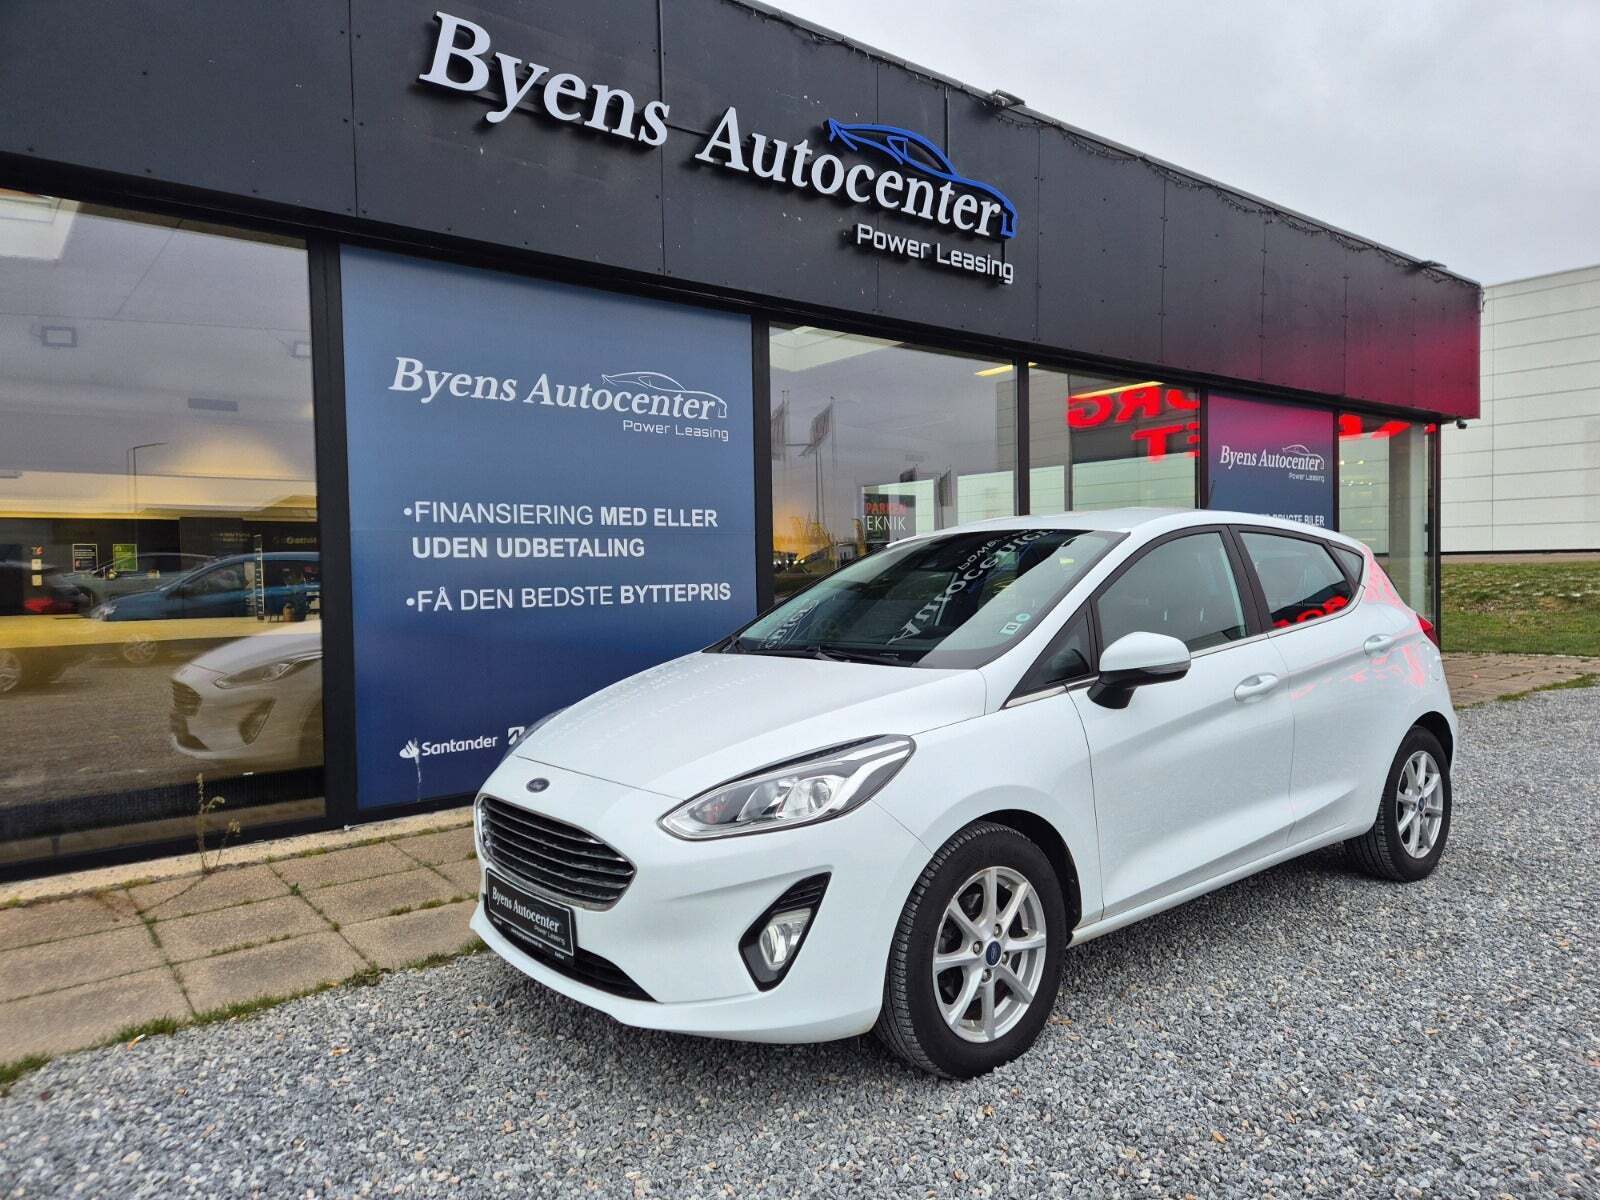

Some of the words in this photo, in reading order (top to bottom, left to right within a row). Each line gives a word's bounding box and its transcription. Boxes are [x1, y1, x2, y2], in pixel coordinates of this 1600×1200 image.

[419, 11, 670, 147] Byens
[695, 106, 1001, 238] Autocenter
[857, 224, 931, 261] Power
[937, 241, 1014, 284] Leasing
[389, 356, 517, 404] Byens
[523, 373, 716, 420] Autocenter
[622, 419, 671, 435] Power
[675, 423, 729, 442] Leasing
[1219, 445, 1257, 469] Byens
[1258, 449, 1320, 471] Autocenter
[414, 501, 594, 526] FINANSIERING
[600, 506, 648, 527] MED
[653, 508, 718, 528] ELLER
[1304, 515, 1325, 526] BILER
[412, 537, 488, 559] UDEN
[496, 537, 645, 558] UDBETALING
[417, 586, 453, 612] FÅ
[460, 588, 514, 611] DEN
[521, 585, 613, 608] BEDSTE
[620, 582, 732, 604] BYTTEPRIS
[421, 735, 498, 756] Santander
[492, 885, 512, 910] Byens
[513, 900, 560, 933] Autocenter
